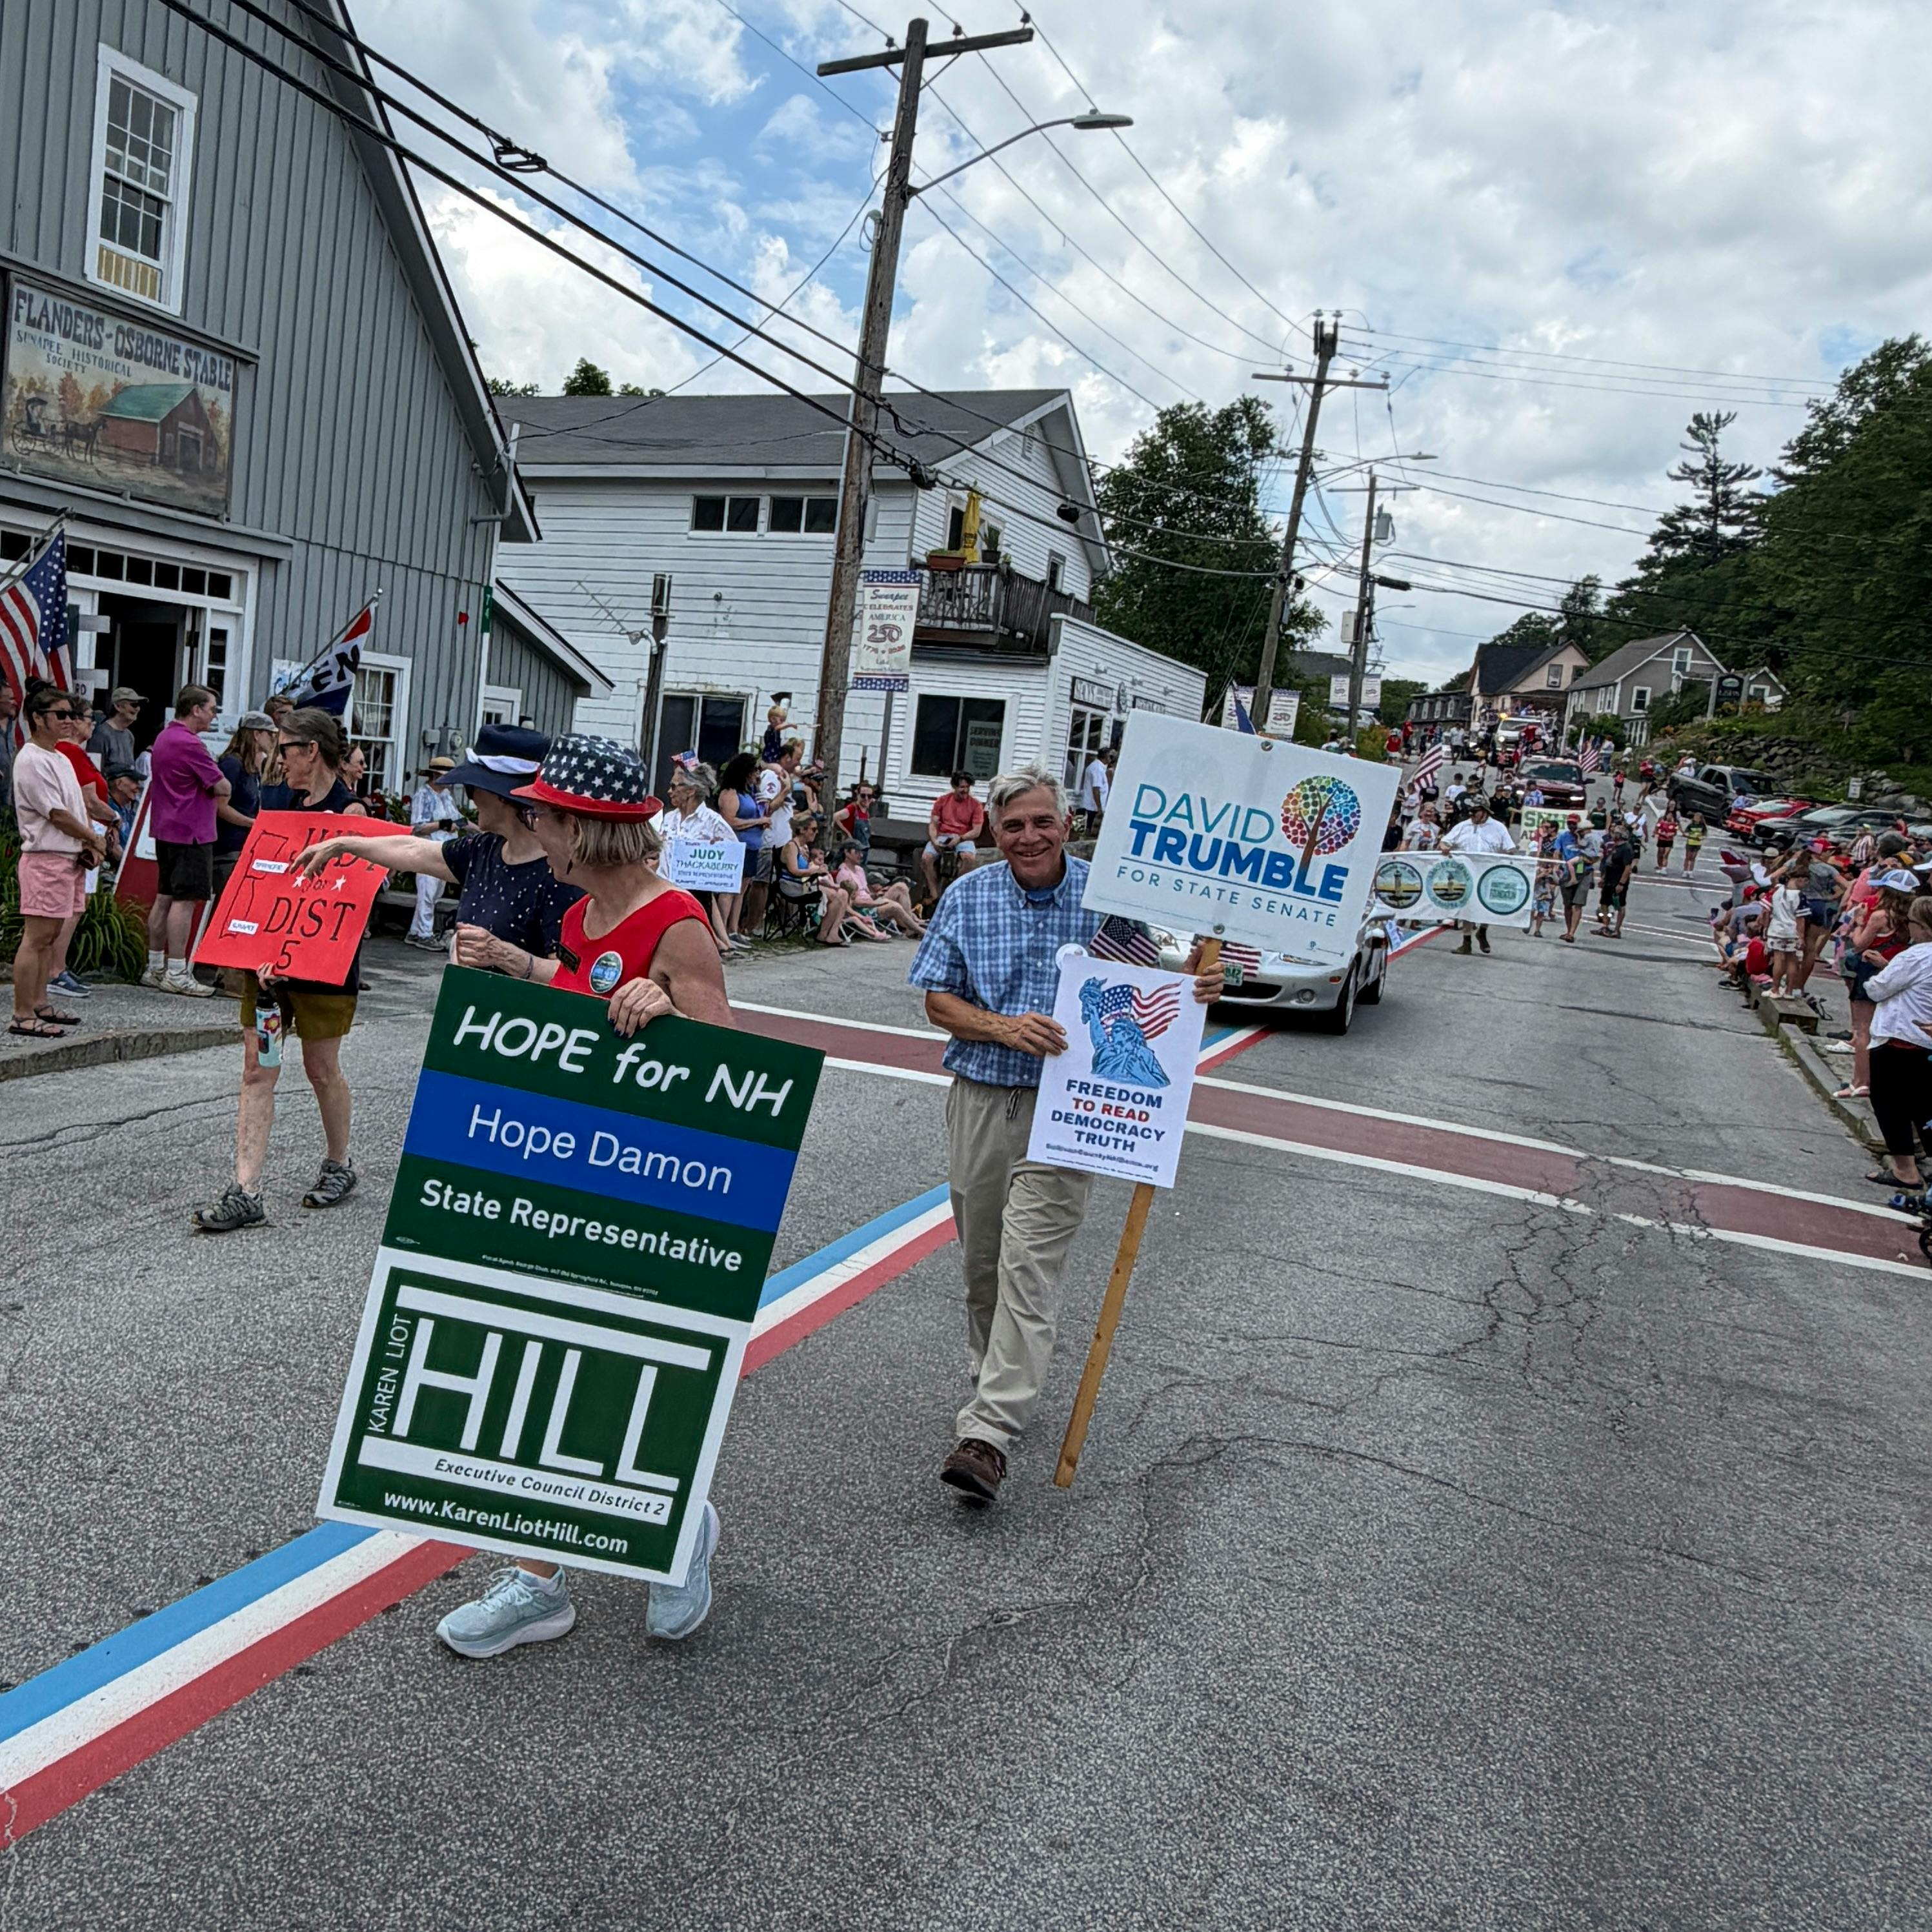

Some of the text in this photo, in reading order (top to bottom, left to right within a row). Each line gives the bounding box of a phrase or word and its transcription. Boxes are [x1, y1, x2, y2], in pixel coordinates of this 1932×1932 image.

[14, 288, 232, 392] FLANDERS-OSBORNE STABLE
[17, 329, 132, 377] SUNAPEE HISTORICAL
[46, 352, 87, 374] SOCIETY
[867, 623, 903, 643] 250
[868, 614, 906, 622] AMERICA
[1273, 712, 1291, 721] 250
[1132, 783, 1274, 844] DAVID
[689, 849, 725, 860] JUDY
[1129, 819, 1349, 903] TRUMBLE
[263, 896, 356, 941] DIST
[1117, 865, 1160, 888] FOR
[1173, 879, 1240, 905] STATE
[1251, 897, 1336, 927] SENATE
[276, 940, 301, 969] 5
[453, 1005, 794, 1117] HOPE for NH
[1066, 1079, 1162, 1109] FREEDOM
[1072, 1098, 1151, 1123] TO READ
[468, 1103, 733, 1194] Hope Damon
[1051, 1110, 1165, 1142] DEMOCRACY
[1074, 1130, 1136, 1152] TRUTH
[419, 1178, 743, 1273] State Representative
[367, 1313, 413, 1433] KAREN LIOT
[392, 1318, 679, 1491] HILL
[434, 1458, 665, 1516] Executive Council District 2
[384, 1492, 629, 1554] www.KarenLiotHill.com
